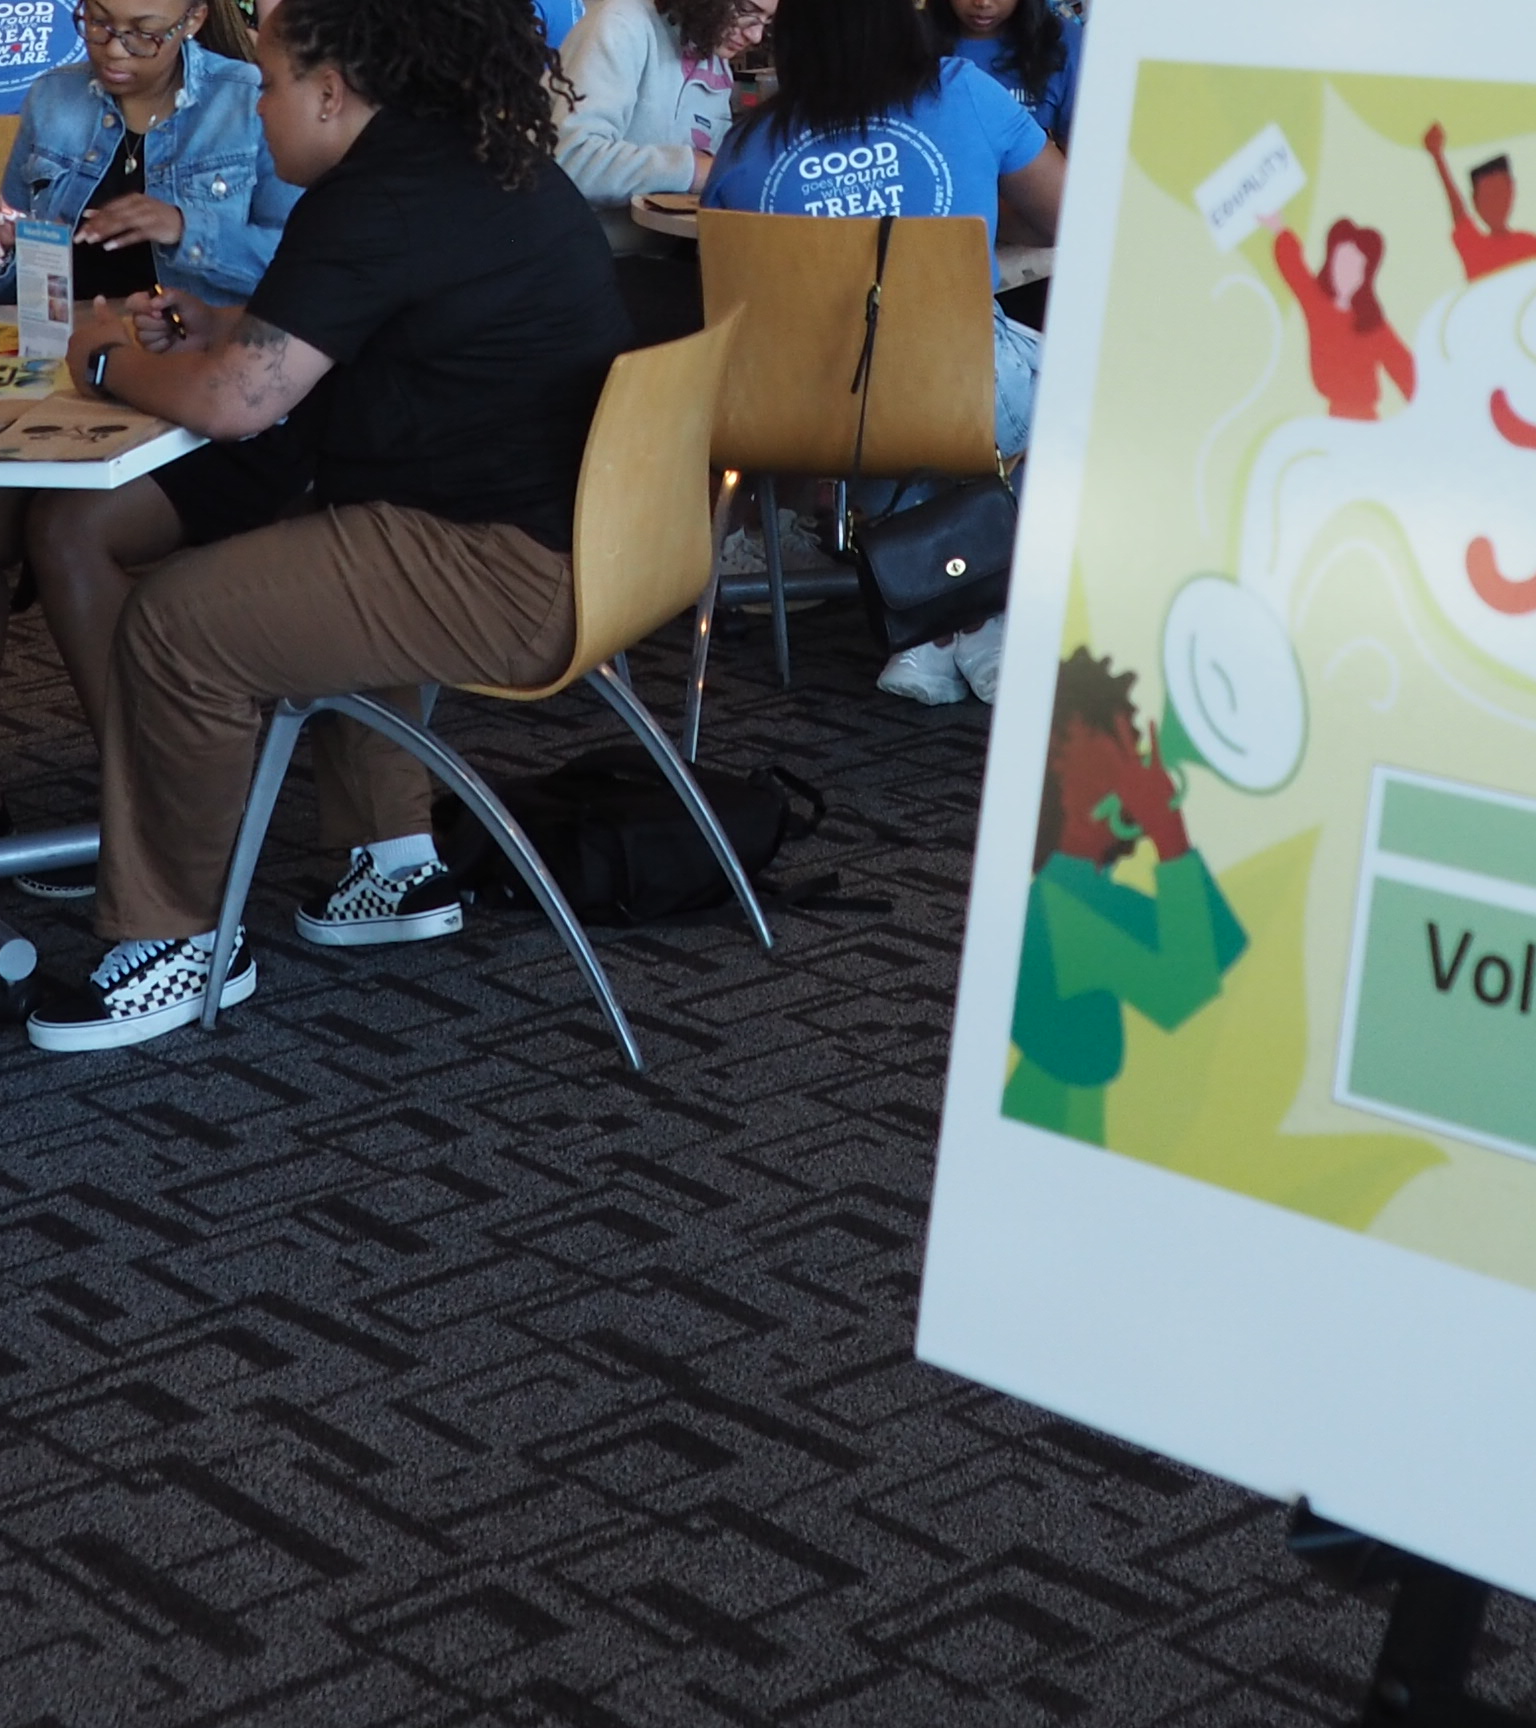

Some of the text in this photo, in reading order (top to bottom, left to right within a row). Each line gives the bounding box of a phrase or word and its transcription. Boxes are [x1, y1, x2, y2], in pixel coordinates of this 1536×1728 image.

[0, 14, 53, 25] round
[799, 142, 897, 179] GOOD
[801, 160, 900, 195] goes round
[804, 184, 904, 218] TREAT
[821, 179, 884, 199] when we
